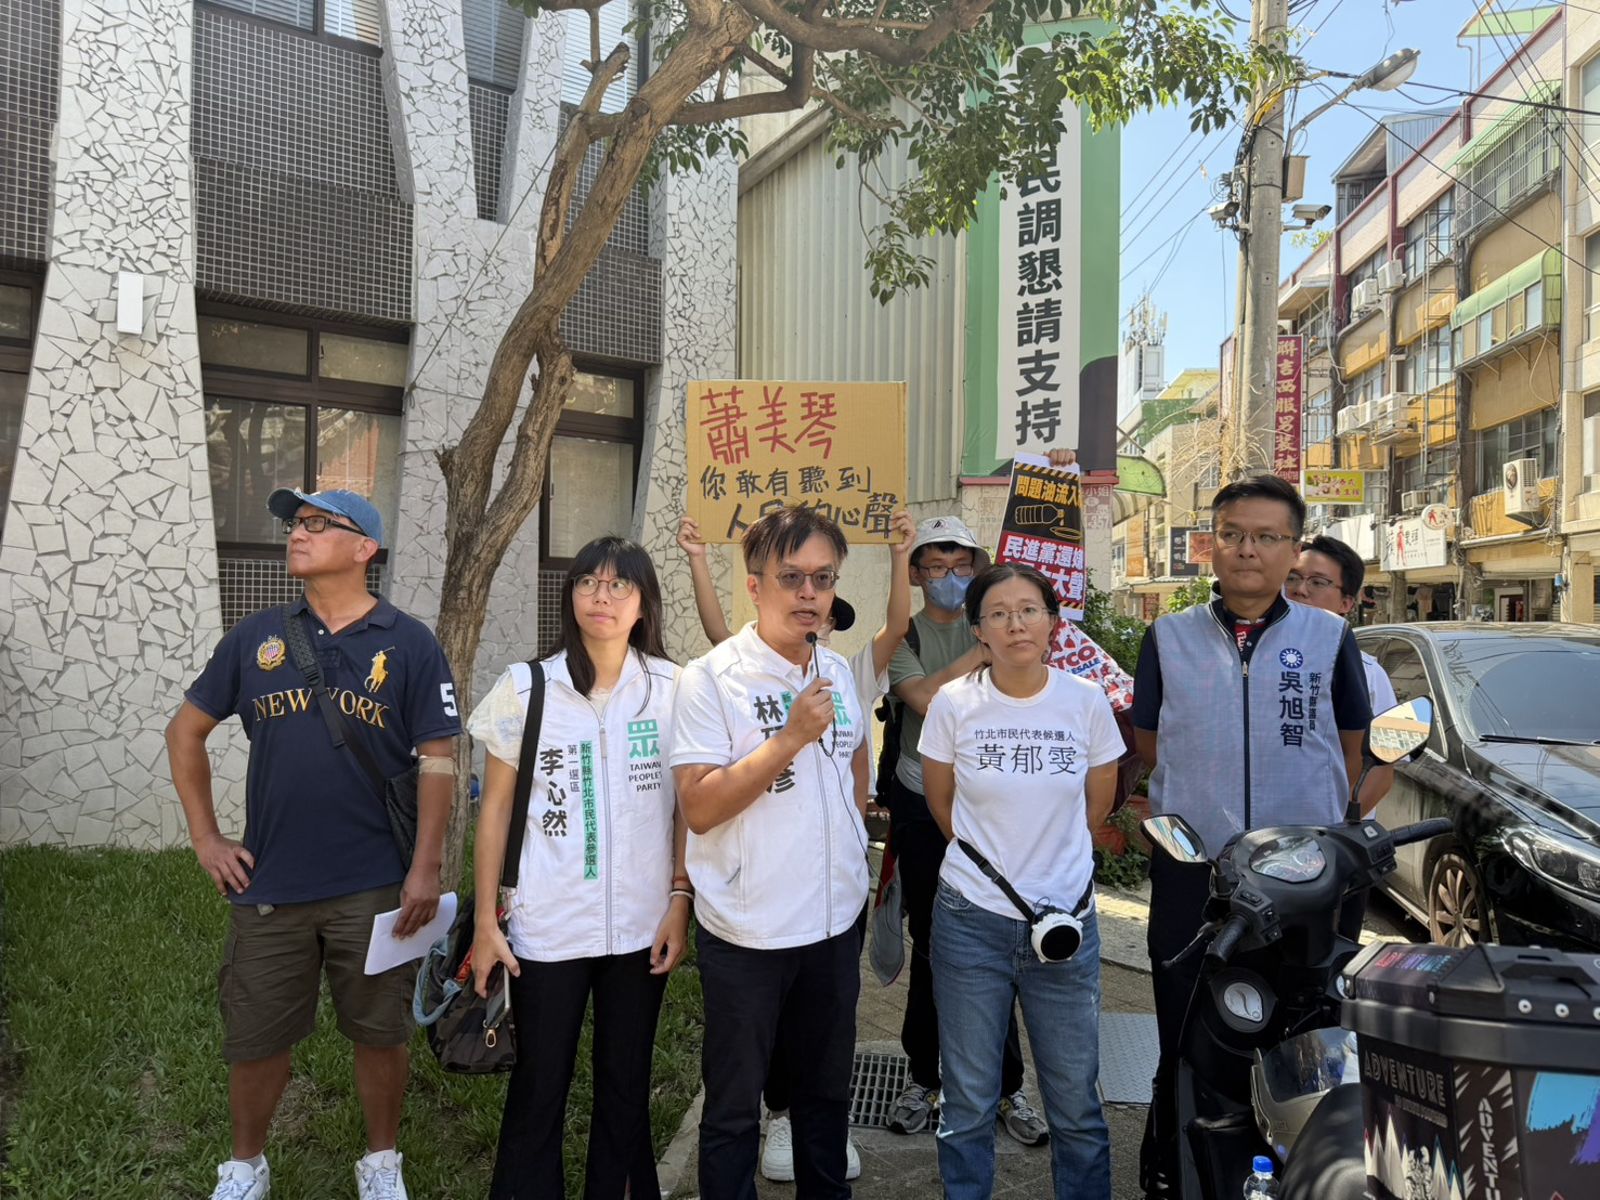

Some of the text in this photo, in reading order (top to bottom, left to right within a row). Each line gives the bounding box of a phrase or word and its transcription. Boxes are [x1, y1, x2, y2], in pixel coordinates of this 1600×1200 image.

[1015, 112, 1063, 446] 民調懇請支持
[700, 385, 837, 465] 蕭美琴
[699, 465, 873, 500] 你敢有聽到
[1048, 645, 1097, 668] TCO
[252, 686, 390, 729] NEW YORK
[439, 682, 459, 717] 5
[1278, 671, 1304, 747] 吳旭智
[974, 728, 1076, 742] 竹北市民代表候選人
[568, 744, 580, 793] 第一選區
[975, 743, 1077, 775] 黃郁雯
[540, 748, 568, 837] 李心然
[636, 782, 662, 793] PARTY
[1364, 1049, 1447, 1108] ADVENTURE
